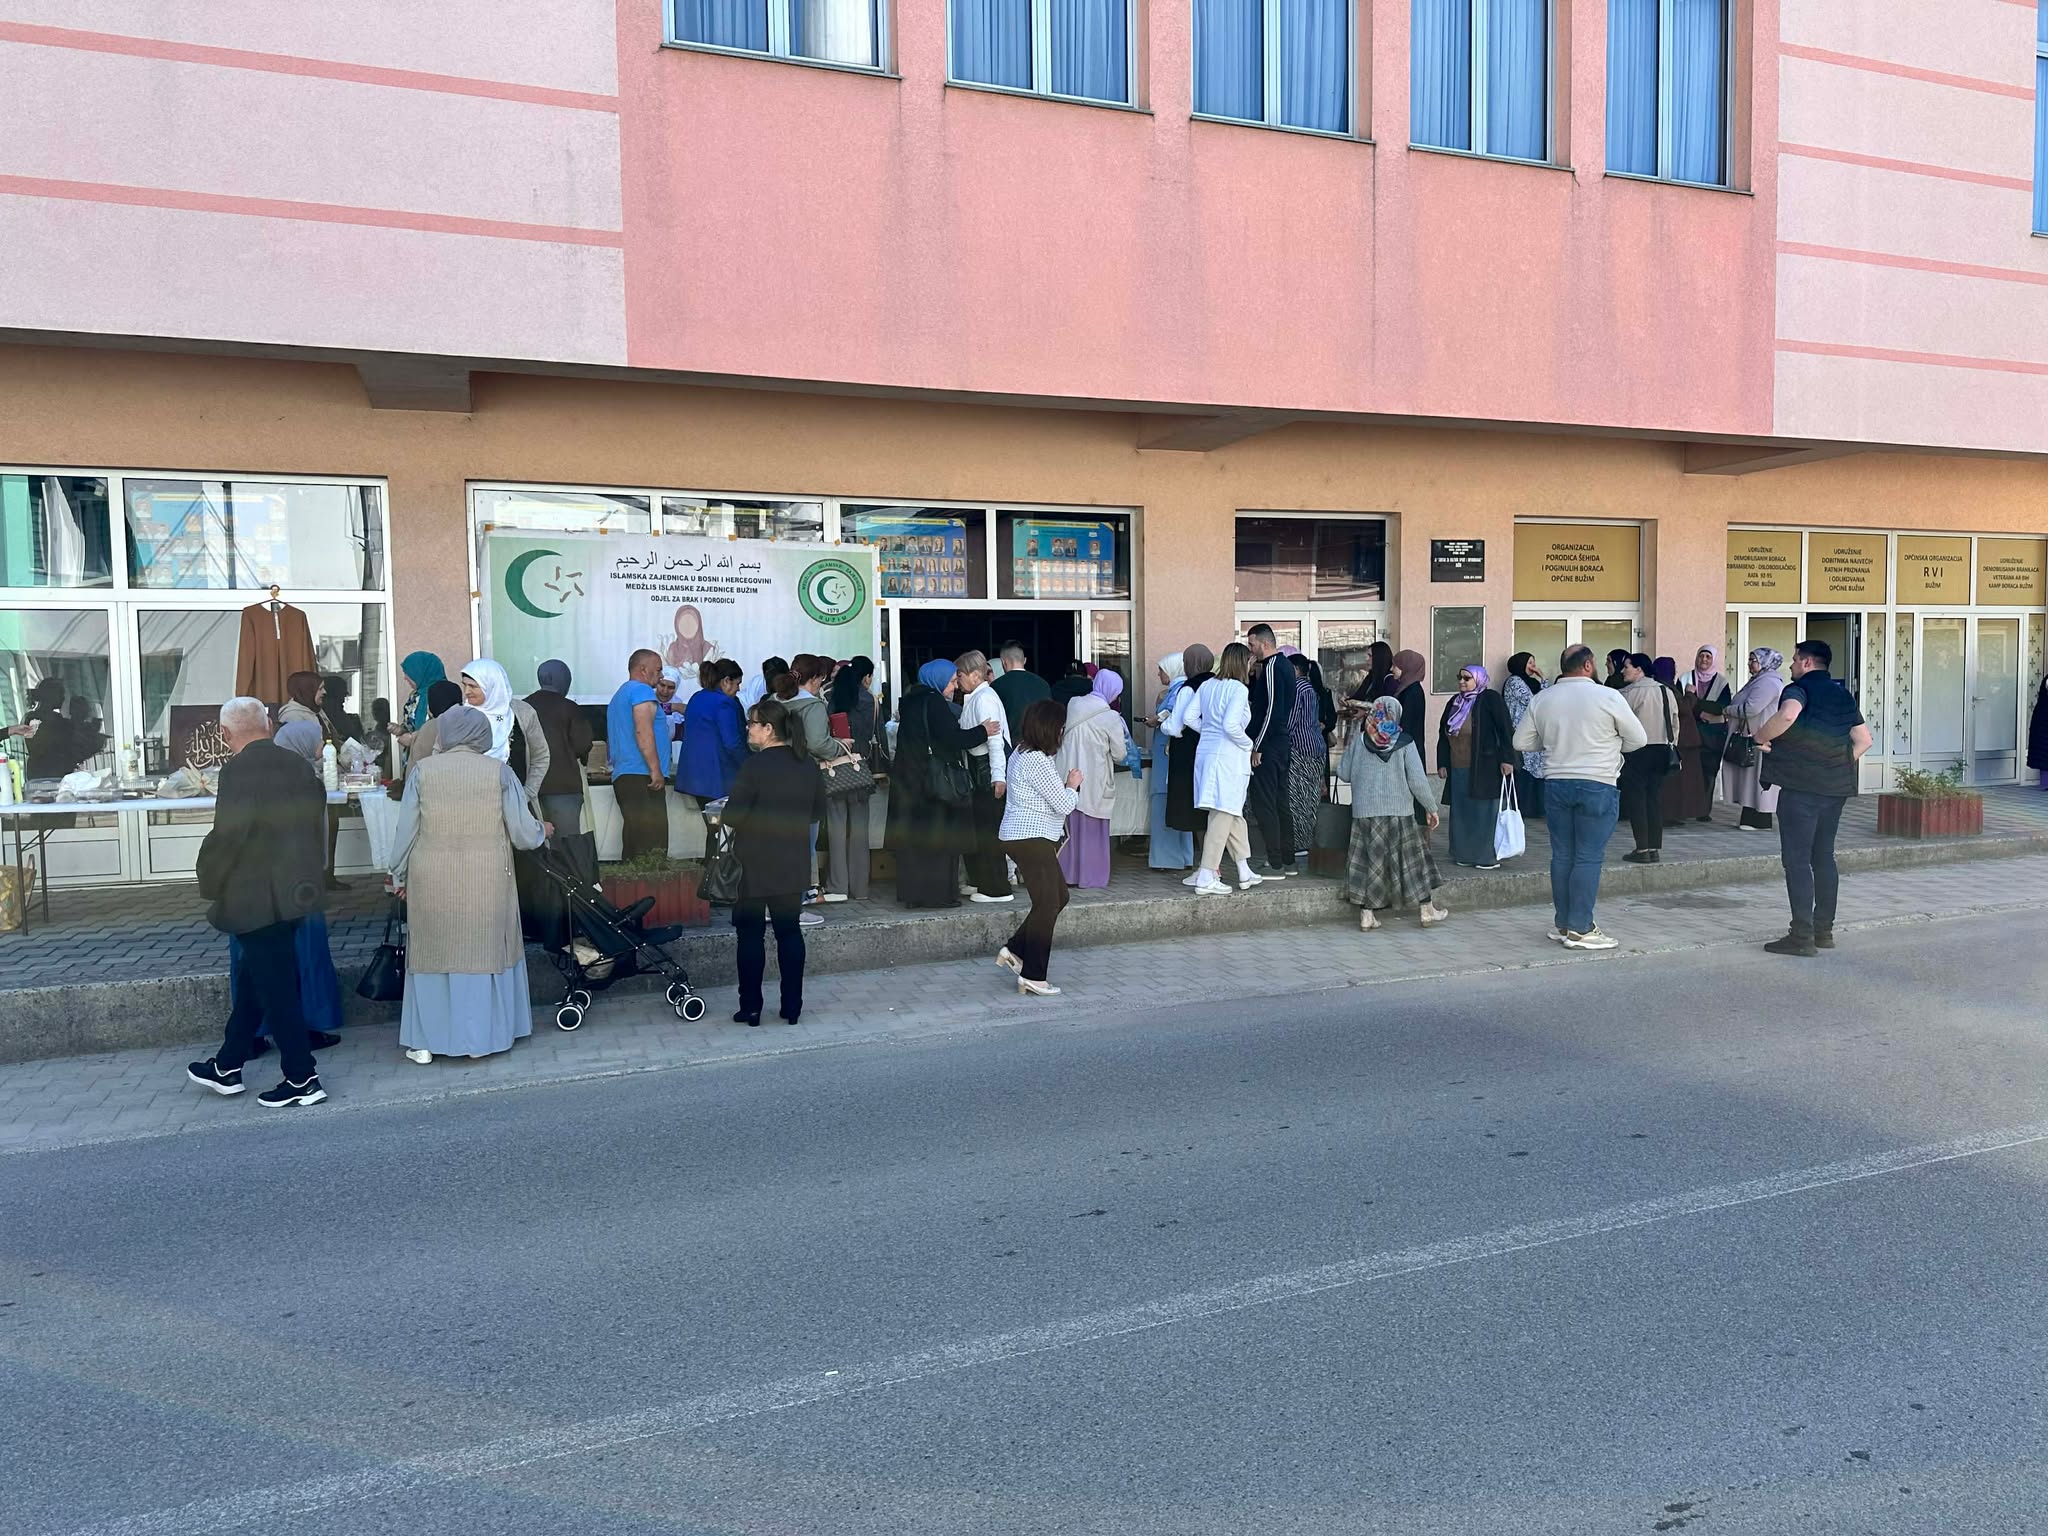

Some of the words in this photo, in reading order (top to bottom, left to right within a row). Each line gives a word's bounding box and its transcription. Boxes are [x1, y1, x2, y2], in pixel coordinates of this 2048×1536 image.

[616, 551, 658, 571] الرحيم
[664, 553, 711, 571] الرحمن
[717, 555, 732, 568] الله
[738, 562, 761, 574] بسم
[1551, 573, 1573, 582] OPĆINE
[1575, 574, 1594, 582] BUŽIM
[626, 582, 656, 590] MEDŽLIS
[737, 586, 758, 594] BUŽIM
